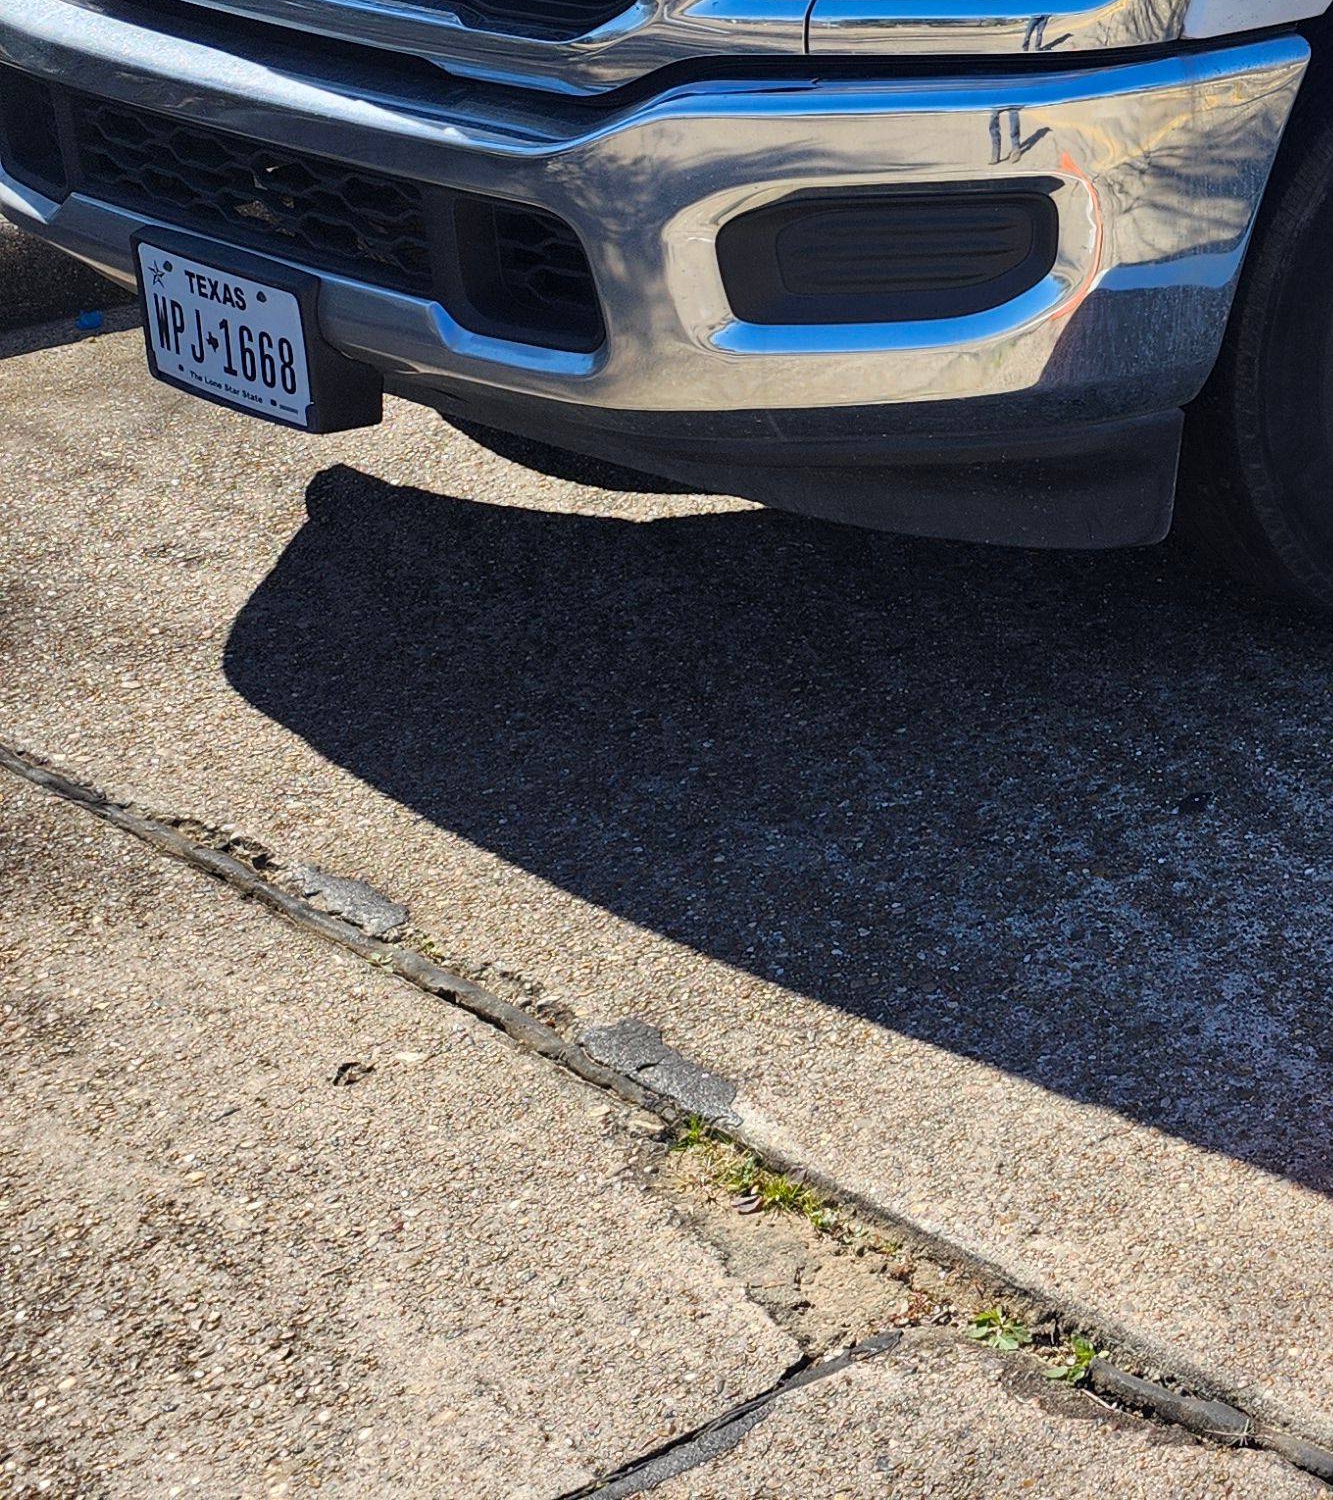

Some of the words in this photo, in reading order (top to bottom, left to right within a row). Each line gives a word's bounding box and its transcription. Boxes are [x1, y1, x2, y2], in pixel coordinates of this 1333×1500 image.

[184, 269, 247, 311] TEXAS
[189, 370, 203, 382] The
[204, 377, 222, 389] Lone
[224, 384, 240, 395] Star
[242, 389, 263, 403] State
